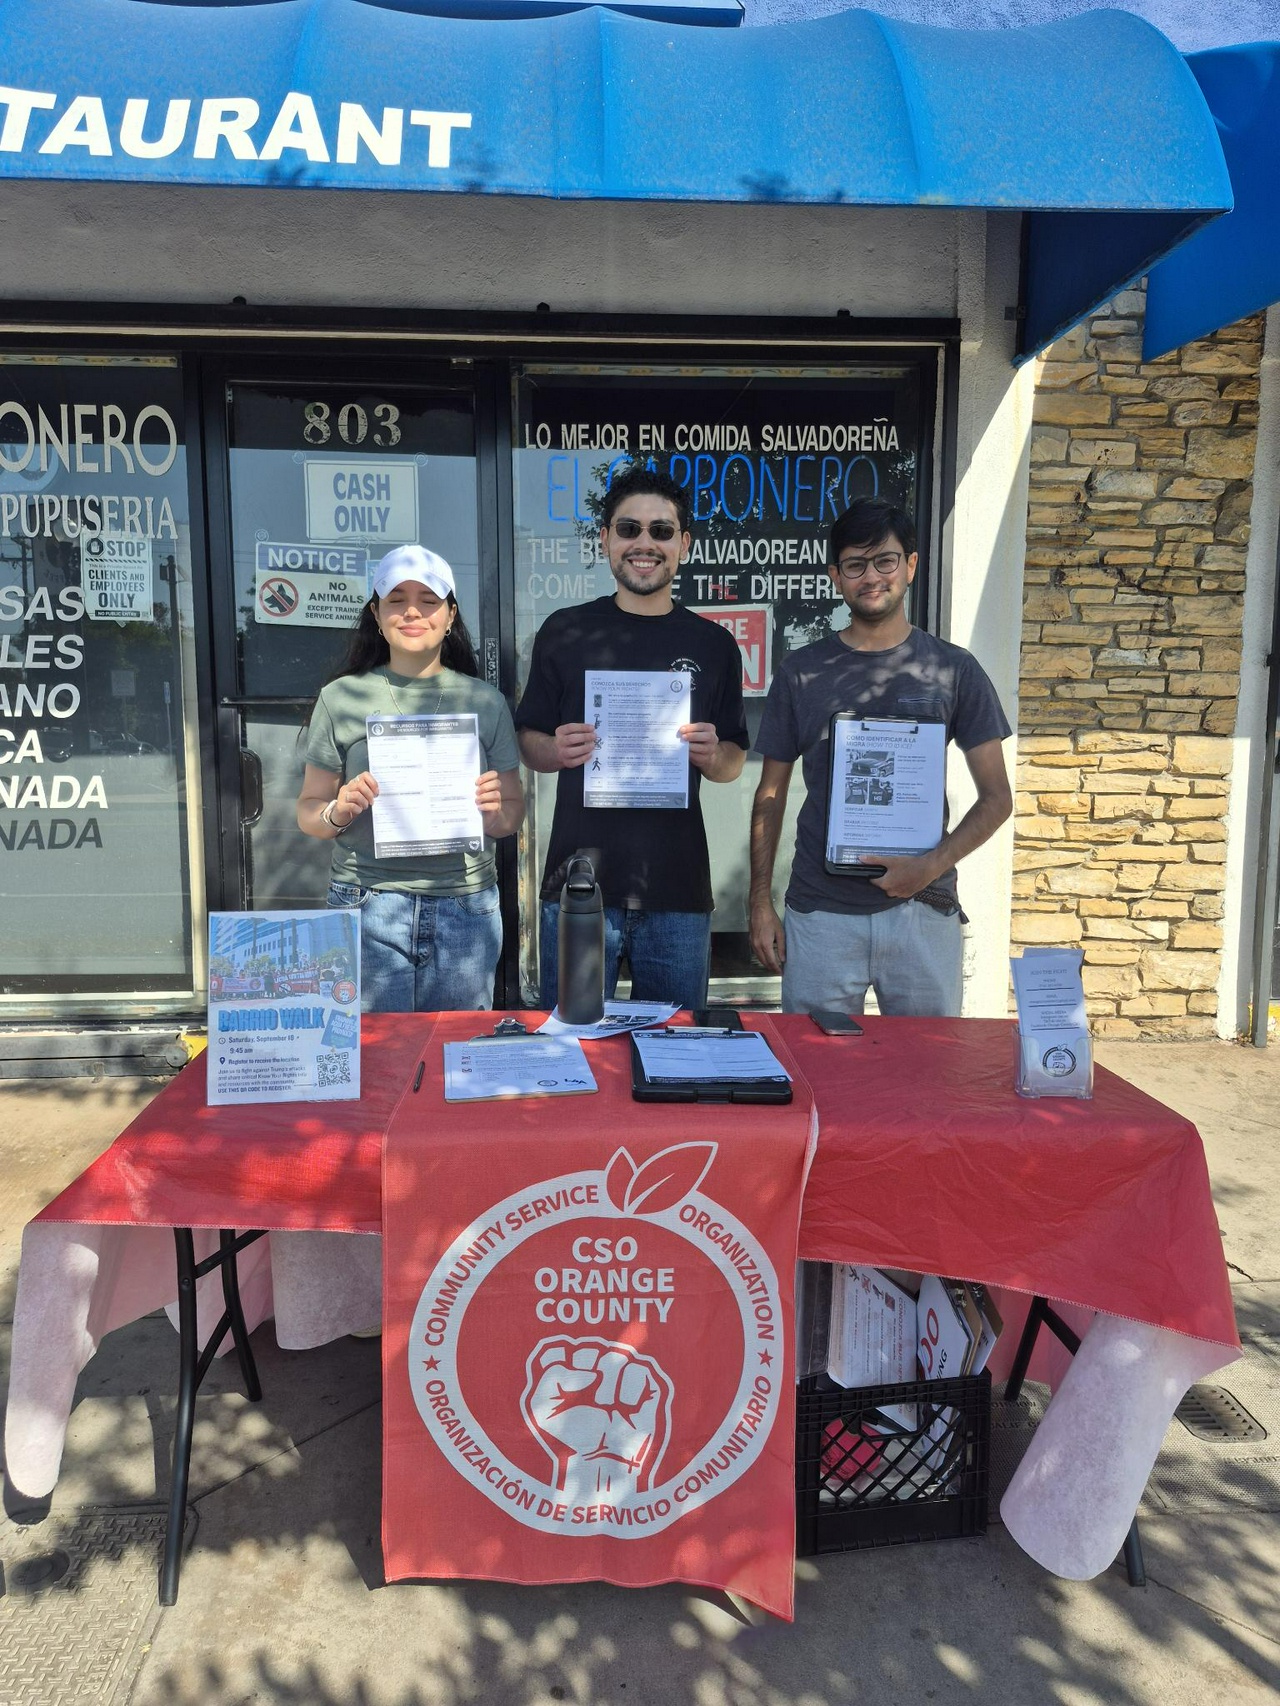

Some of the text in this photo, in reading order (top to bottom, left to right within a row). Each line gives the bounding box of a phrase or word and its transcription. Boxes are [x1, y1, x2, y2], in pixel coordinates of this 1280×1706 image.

[0, 86, 472, 168] TAURANT
[303, 402, 402, 446] 803
[525, 418, 900, 452] LO MEJOR EN COMIDA SALVADOREÑA
[0, 401, 177, 476] ONERO
[333, 473, 391, 501] CASH
[548, 455, 592, 521] EL
[1, 494, 178, 540] PUPUSERIA
[334, 506, 391, 532] ONLY
[107, 540, 146, 557] STOP
[268, 548, 357, 573] NOTICE
[527, 539, 568, 564] THE
[580, 539, 608, 564] BE
[88, 570, 128, 580] CLIENTS
[90, 581, 144, 592] EMPLOYEES
[329, 582, 347, 591] NO
[528, 574, 596, 600] COME
[693, 575, 738, 600] THE
[751, 575, 844, 600] DIFFER
[0, 586, 85, 622] SAS
[98, 592, 135, 608] ONLY
[309, 593, 364, 604] ANIMALS
[305, 612, 333, 620] SERVICE
[0, 634, 84, 670] LES
[0, 775, 108, 809] NADA
[218, 1008, 279, 1032] BARRIO
[280, 1007, 326, 1030] WALK
[572, 1236, 638, 1264] CSO
[424, 1184, 599, 1347] COMMUNITY SERVICE
[678, 1204, 775, 1341] ORGANIZATION
[534, 1267, 675, 1294] ORANGE
[535, 1297, 675, 1324] COUNTY
[426, 1374, 772, 1526] ORGANIZACIÓN DE SERVICIO COMUNITARIO
